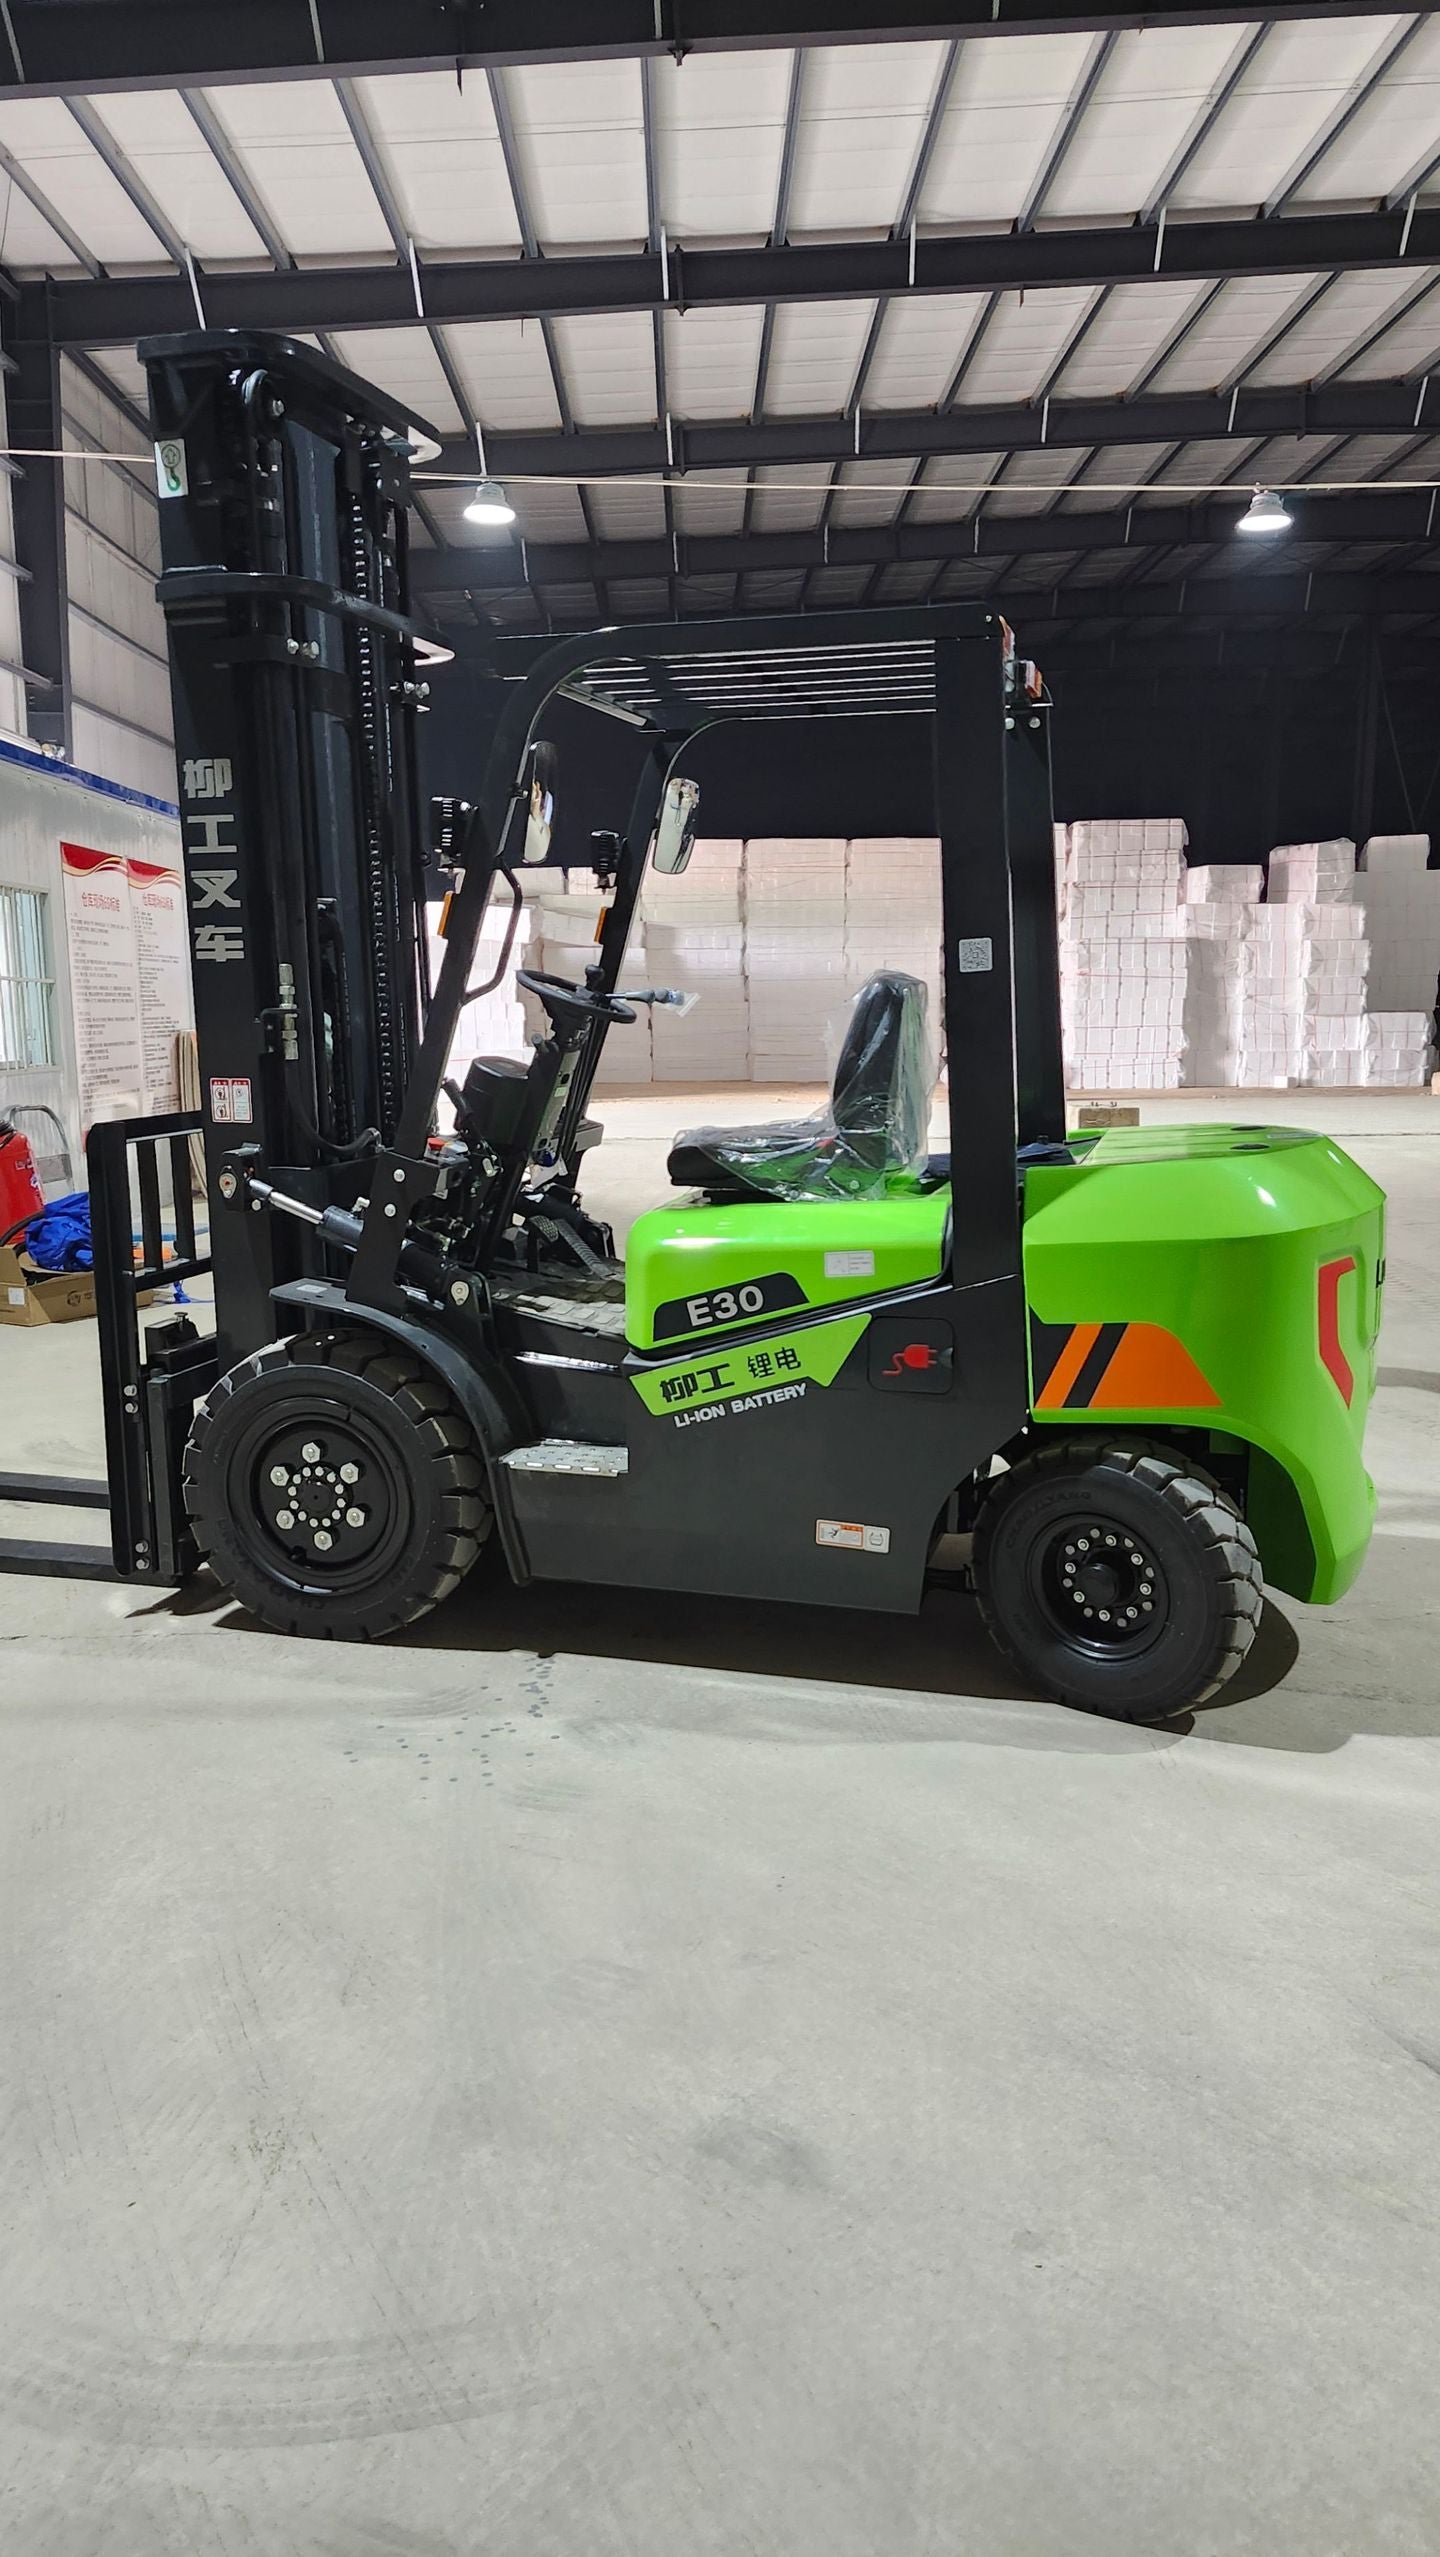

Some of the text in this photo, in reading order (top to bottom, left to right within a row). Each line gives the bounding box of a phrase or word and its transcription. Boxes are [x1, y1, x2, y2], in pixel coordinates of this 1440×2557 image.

[183, 758, 245, 963] 柳工叉车
[686, 1285, 764, 1326] E30
[660, 1347, 801, 1403] 柳工 锂电
[674, 1383, 807, 1428] LI-ION BATTERY
